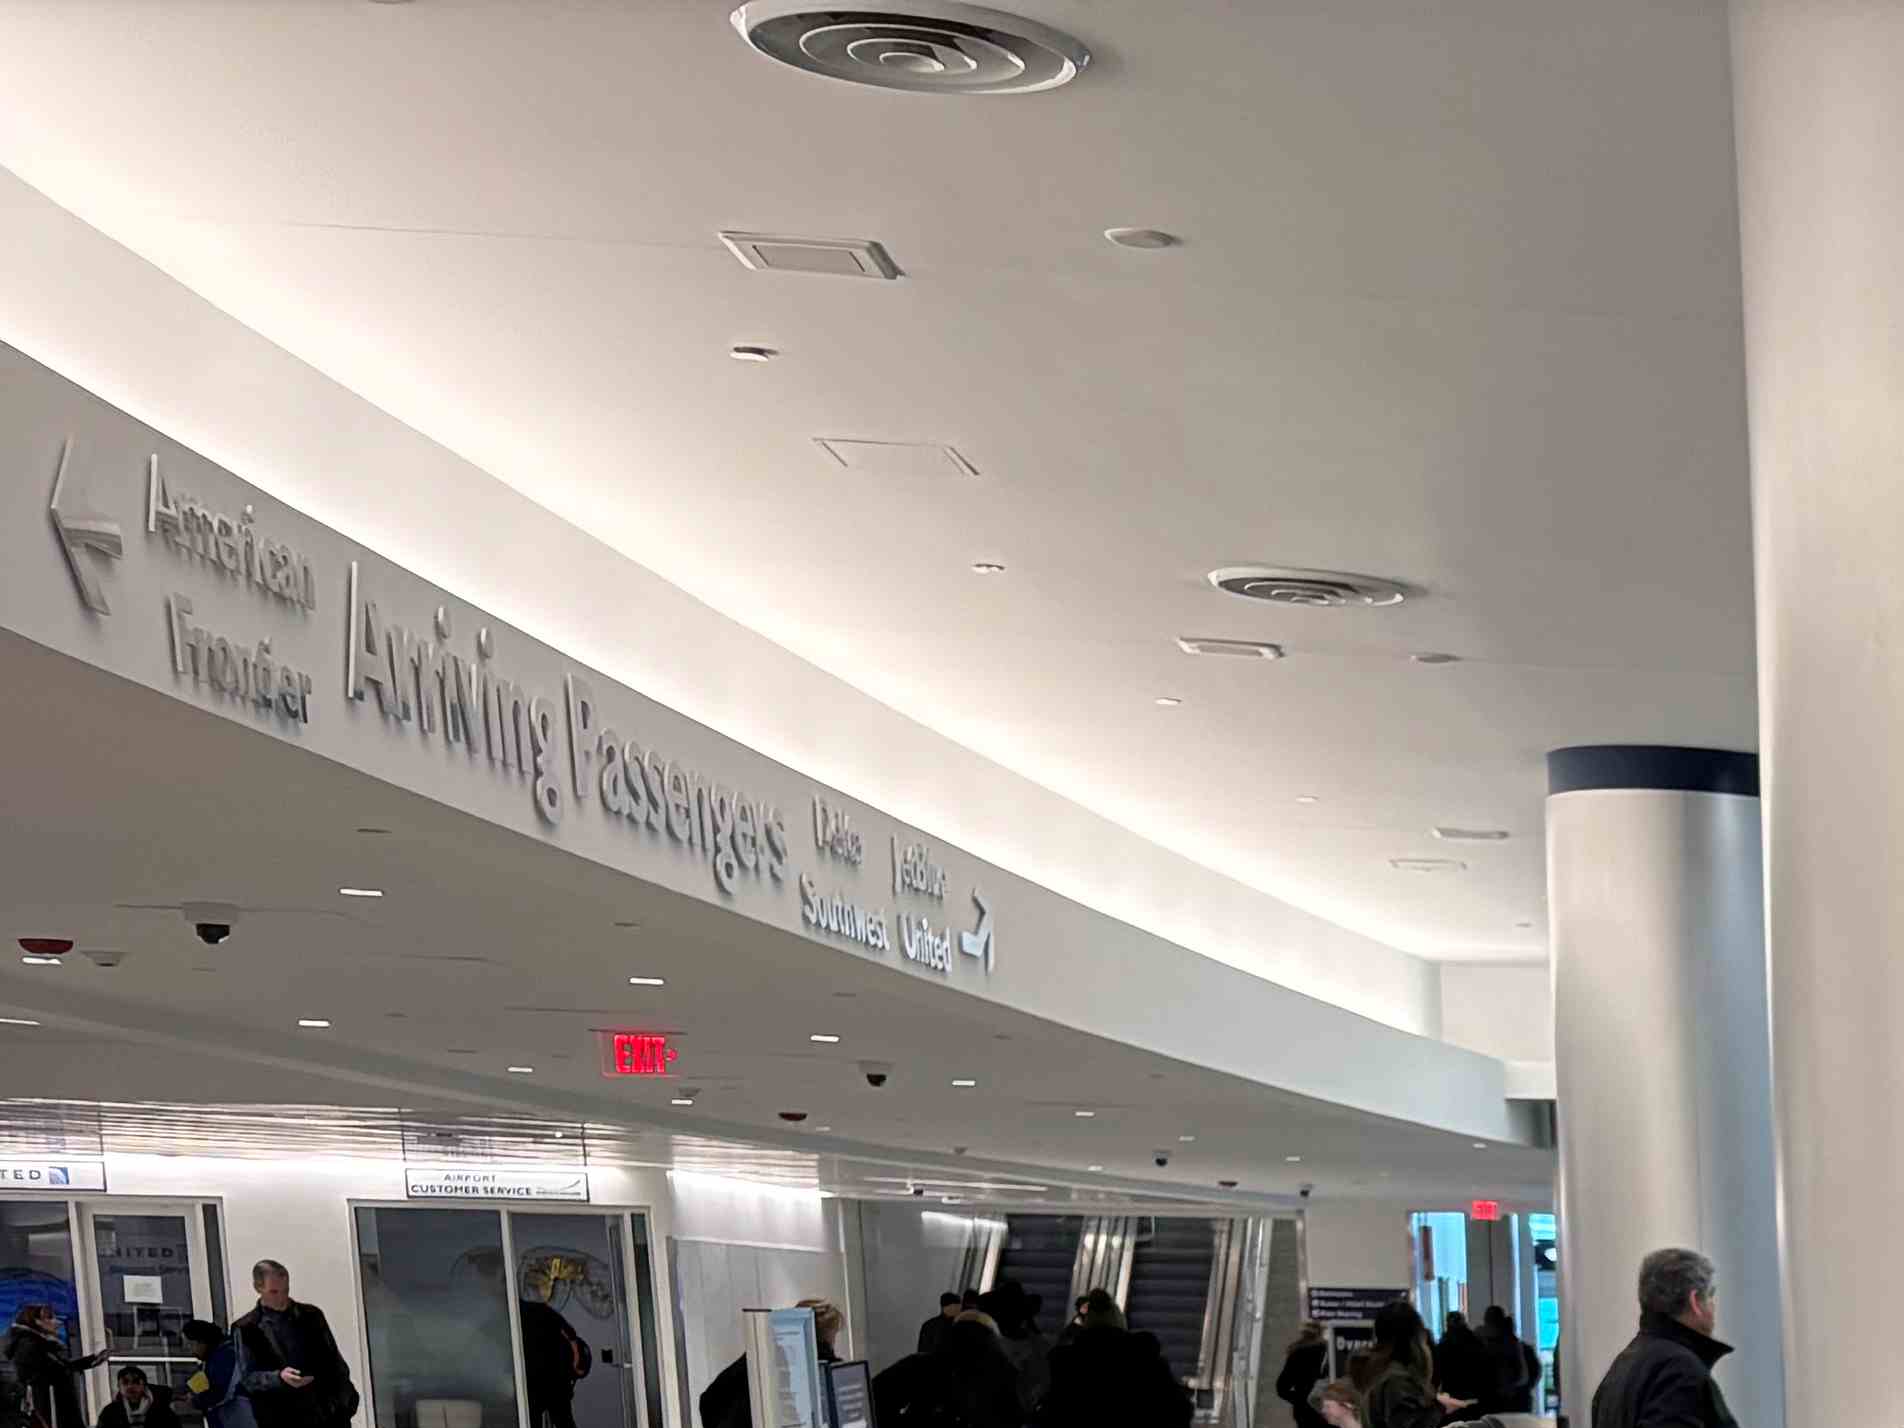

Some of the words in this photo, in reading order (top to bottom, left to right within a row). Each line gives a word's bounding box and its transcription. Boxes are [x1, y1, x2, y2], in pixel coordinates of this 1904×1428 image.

[148, 453, 316, 611] American
[167, 592, 312, 724] Frontier
[347, 559, 562, 826] Arriving
[565, 671, 788, 895] Passengers
[800, 871, 890, 950] Southwest
[897, 912, 952, 973] United
[614, 1034, 667, 1074] EXIT
[411, 1184, 480, 1195] CUSTOMER
[483, 1185, 531, 1197] SERVICE
